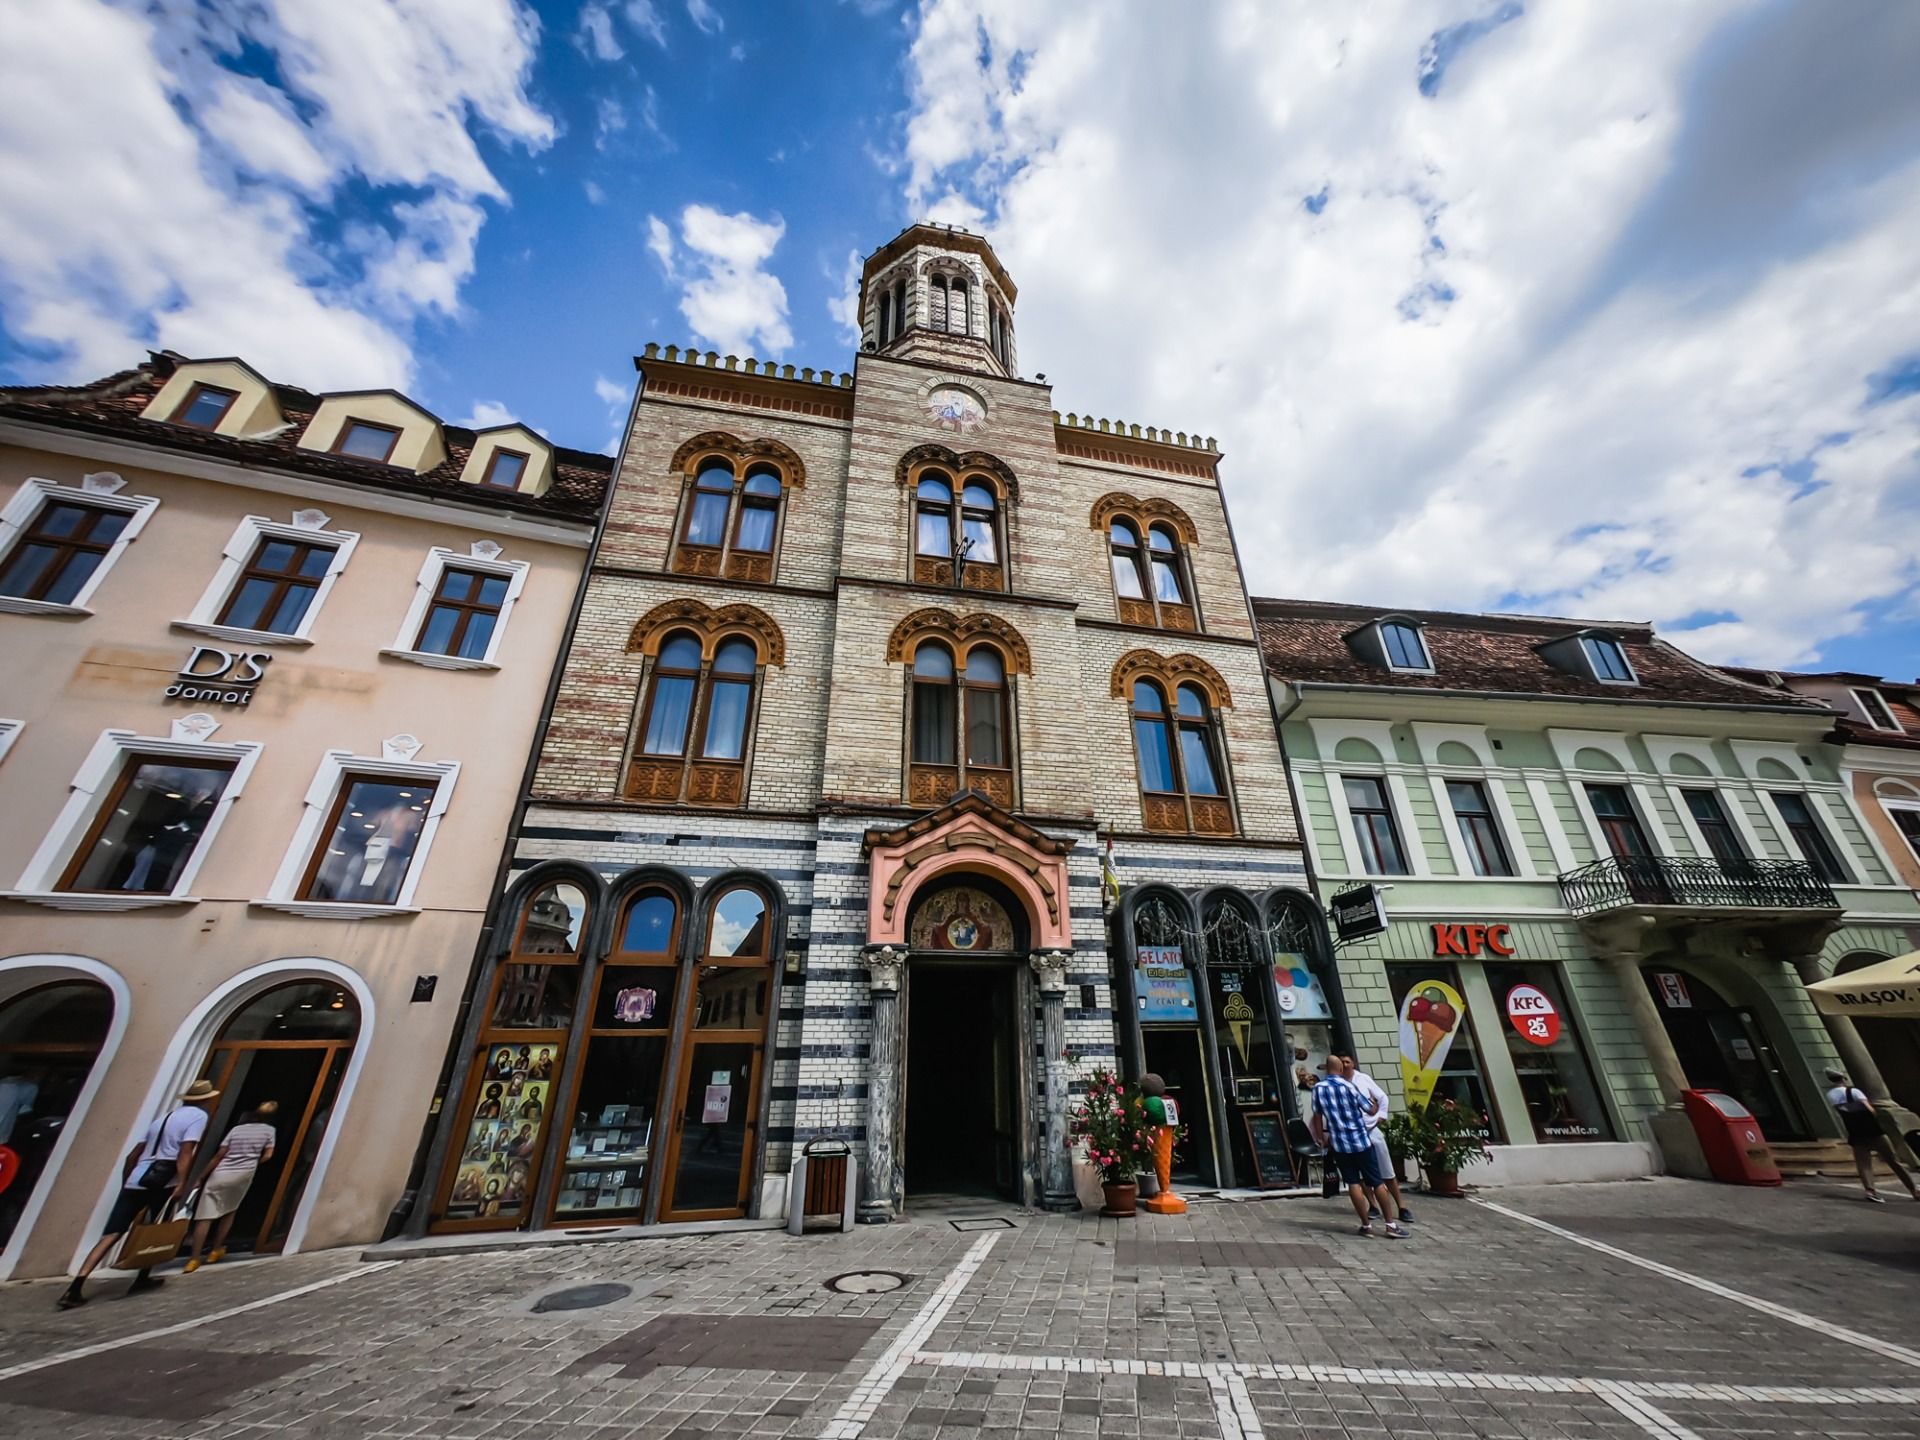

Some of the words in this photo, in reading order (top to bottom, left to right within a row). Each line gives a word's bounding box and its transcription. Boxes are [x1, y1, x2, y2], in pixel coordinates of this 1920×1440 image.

[178, 646, 273, 682] D'S
[165, 683, 252, 704] damat
[1432, 924, 1515, 956] KFC
[1512, 996, 1544, 1010] KFC
[1527, 1017, 1547, 1036] 25
[1543, 1125, 1600, 1136] www.kfc.ro
